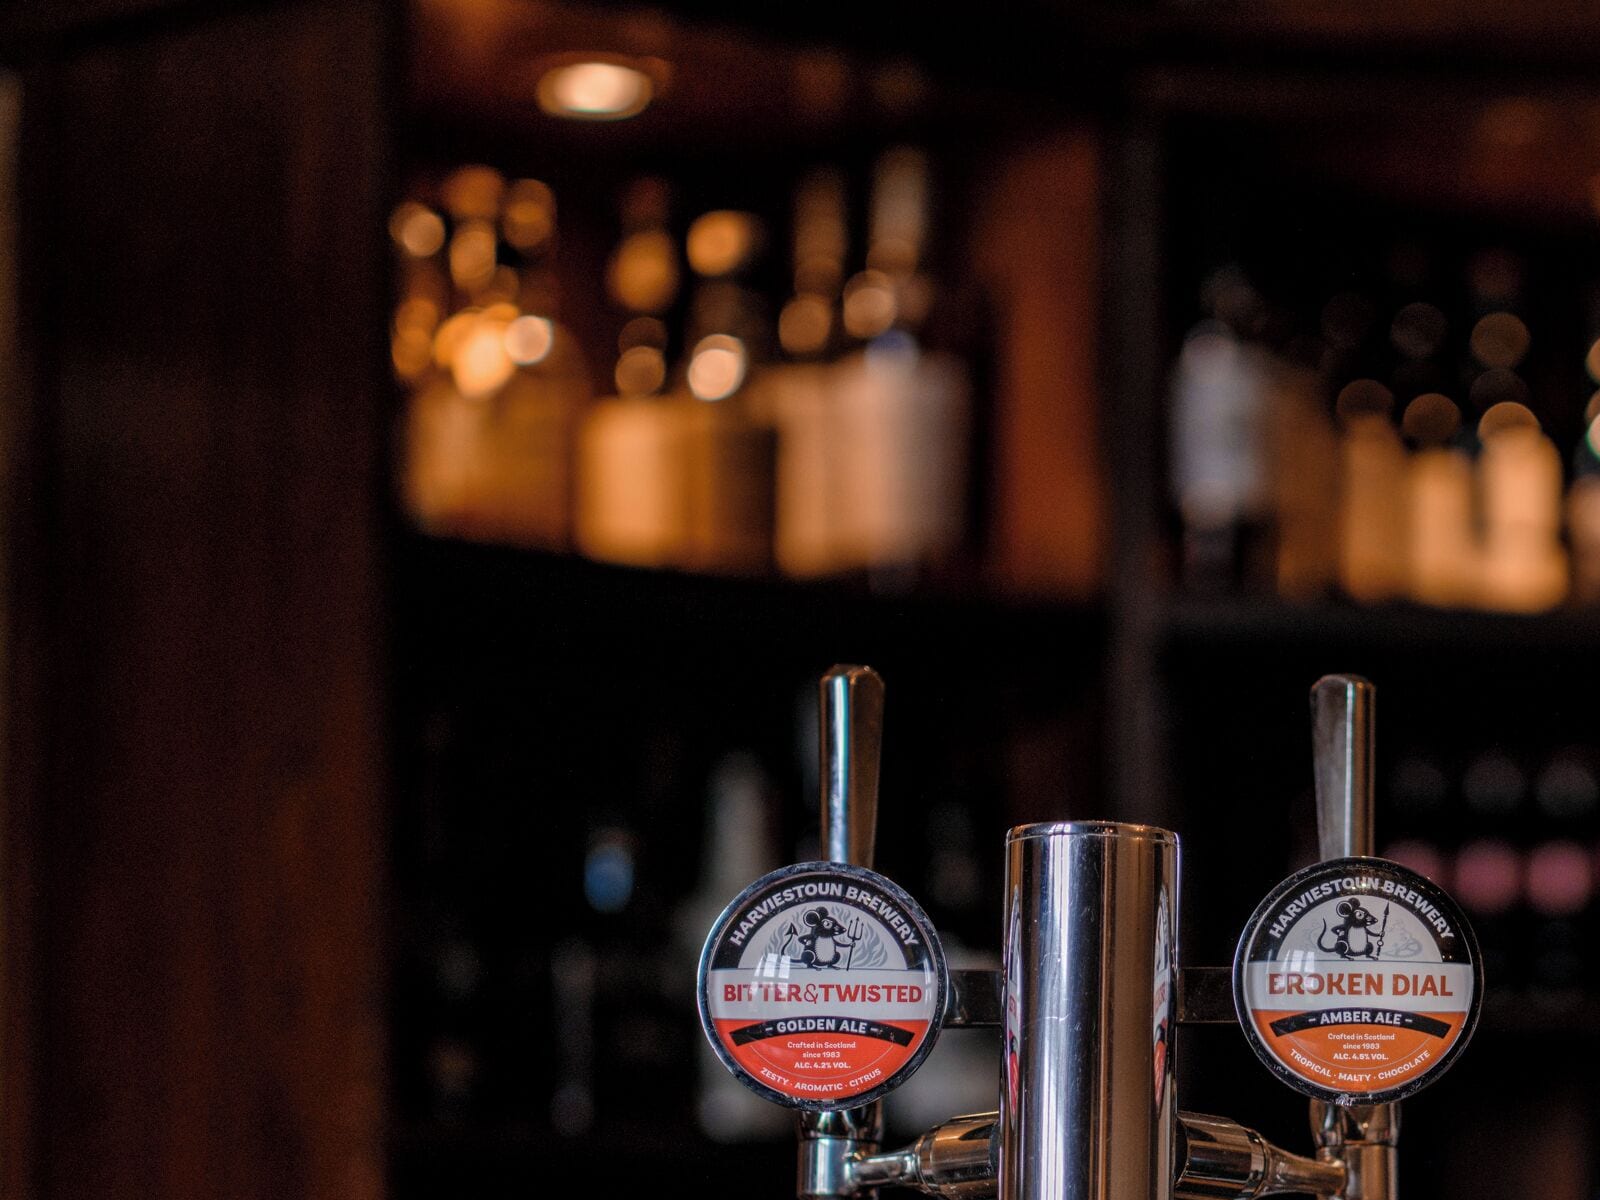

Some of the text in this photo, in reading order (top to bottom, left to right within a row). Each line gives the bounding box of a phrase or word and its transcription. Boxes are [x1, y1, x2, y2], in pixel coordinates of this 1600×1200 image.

[729, 883, 919, 947] HARVIESTOUN BREWERY
[1269, 877, 1455, 941] HARVIESTOUN BREWERY
[724, 984, 922, 1004] BITTER&TWISTED
[1268, 973, 1453, 997] BROKEN DIAL
[777, 1018, 868, 1033] GOLDEN ALE
[1320, 1011, 1402, 1025] AMBER ALE
[787, 1041, 815, 1049] Crafted
[824, 1041, 856, 1049] Scotland
[1290, 1048, 1431, 1082] TROPICAL MALTY CHOCOLATE
[760, 1067, 881, 1092] ZESTY AROMATIC CITRUS
